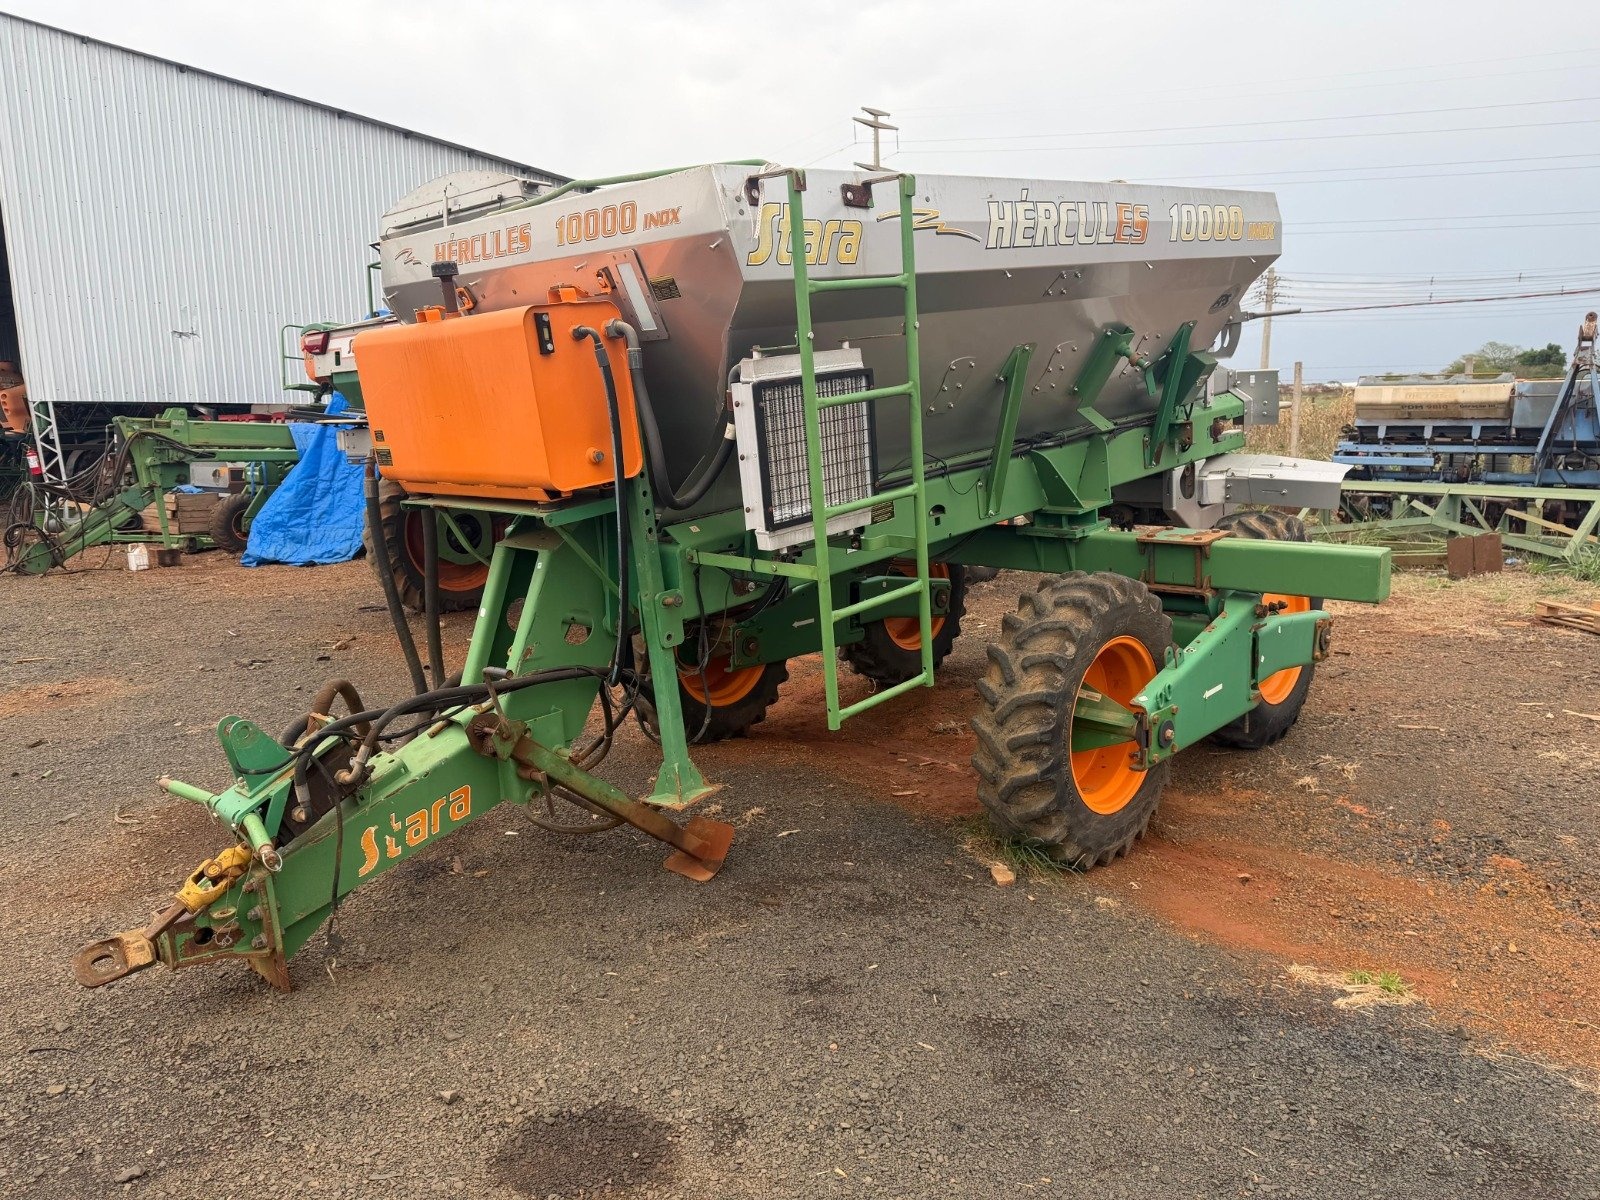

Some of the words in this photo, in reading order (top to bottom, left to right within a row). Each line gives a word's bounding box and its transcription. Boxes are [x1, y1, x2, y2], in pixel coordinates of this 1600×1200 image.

[434, 222, 532, 266] HÉRCULES
[555, 200, 638, 247] 10000
[642, 205, 682, 231] INOX
[746, 201, 863, 266] Stara
[985, 188, 1150, 250] HÉRCULES
[1168, 203, 1244, 242] 10000
